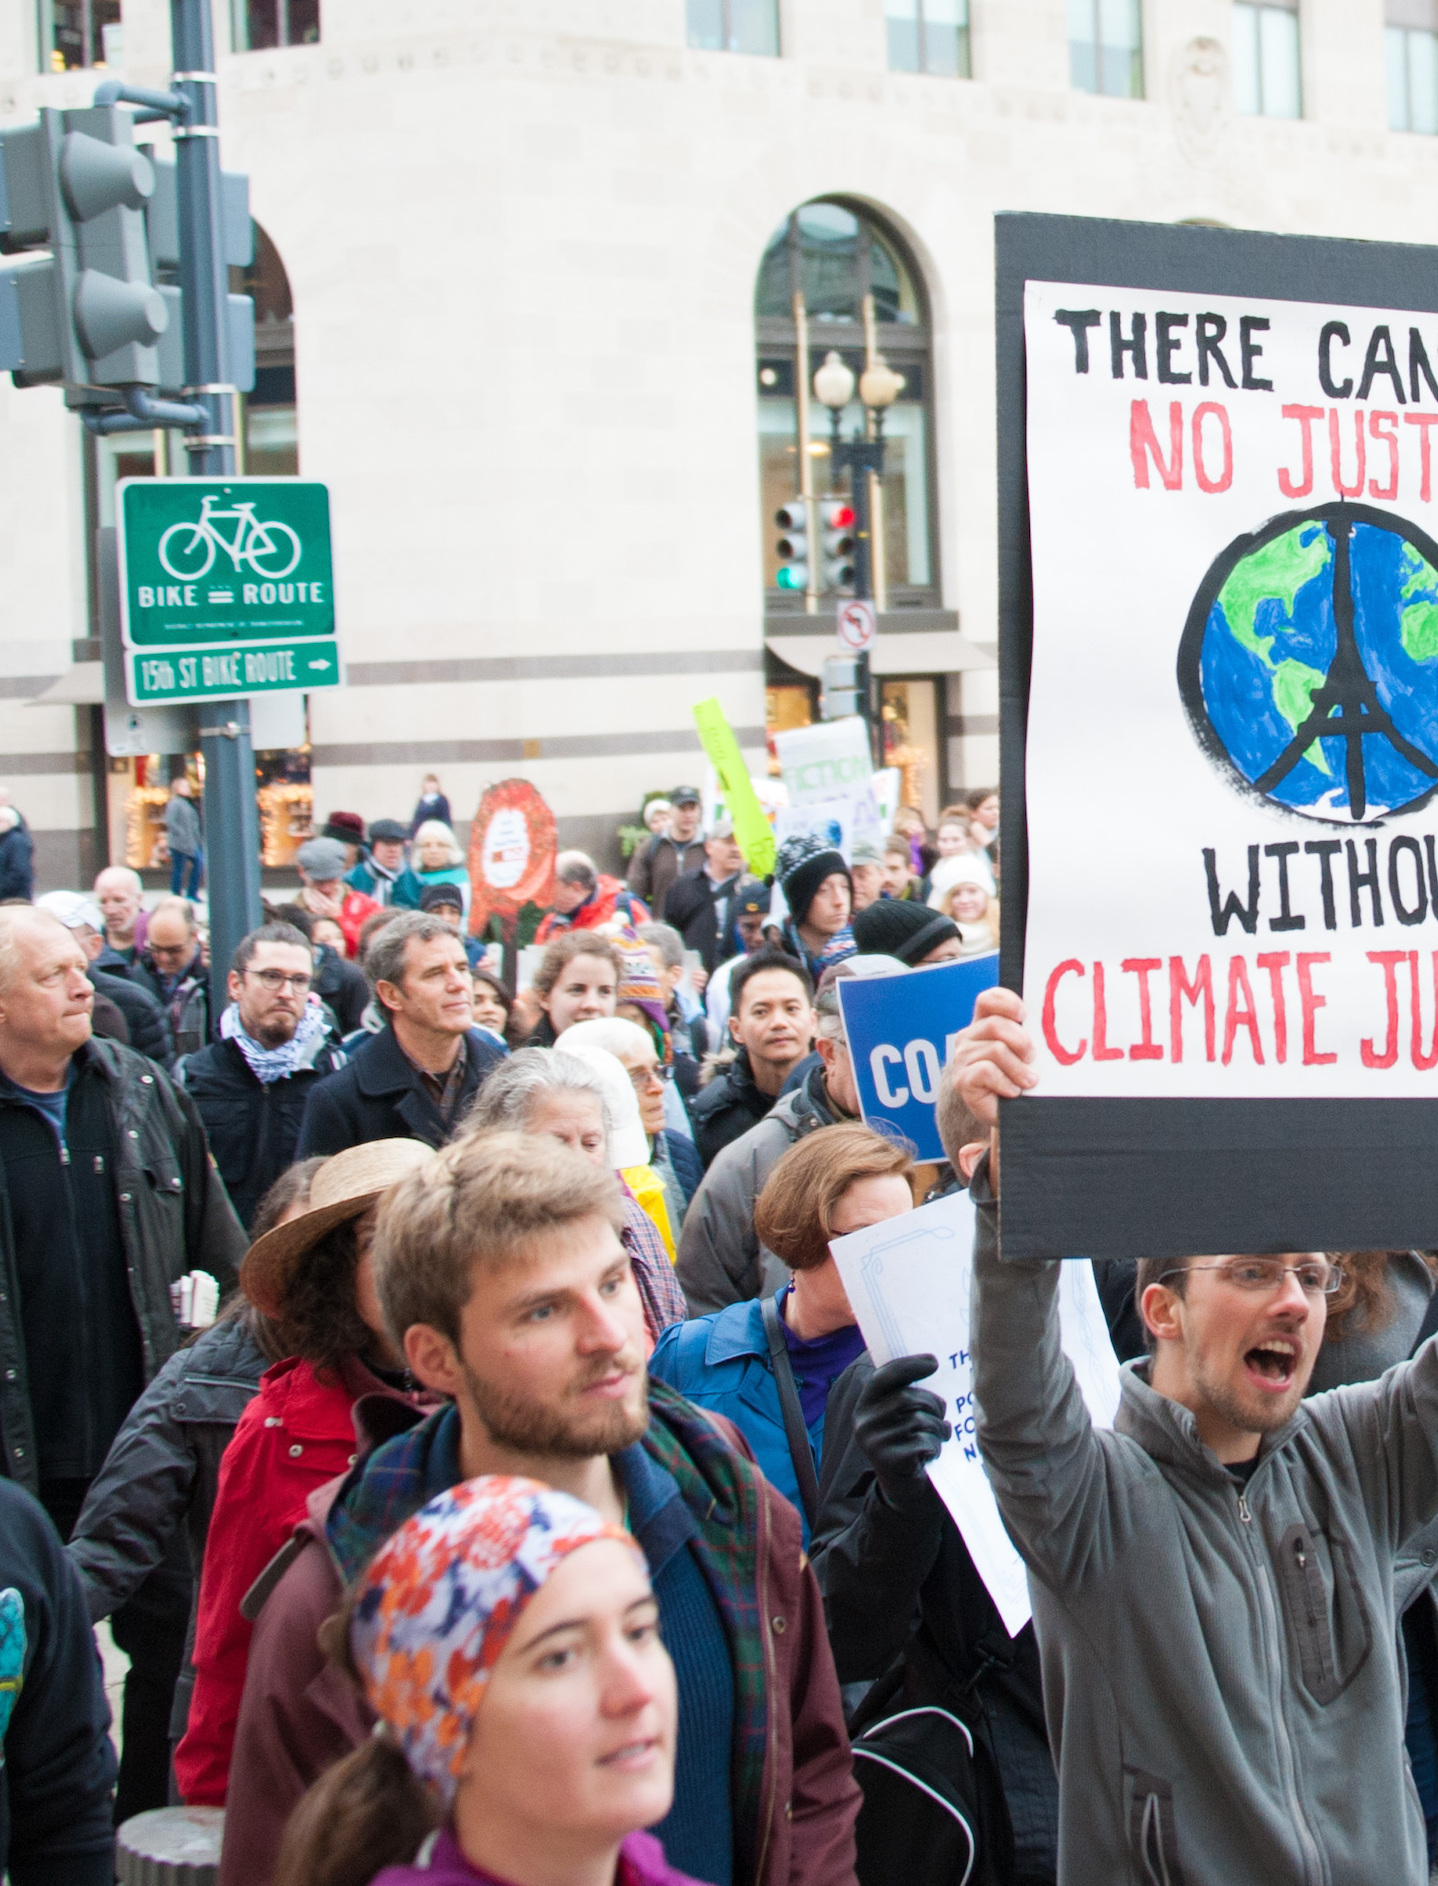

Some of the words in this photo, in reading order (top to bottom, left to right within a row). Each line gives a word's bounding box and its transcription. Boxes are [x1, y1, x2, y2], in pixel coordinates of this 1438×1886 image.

[1051, 309, 1275, 392] THERE
[1129, 399, 1234, 493] NO
[138, 585, 199, 608] BIKE
[243, 582, 325, 605] ROUTE
[178, 657, 198, 688] ST
[202, 654, 243, 686] BIKE
[244, 650, 297, 683] ROUTE
[1041, 951, 1337, 1067] CLIMATE
